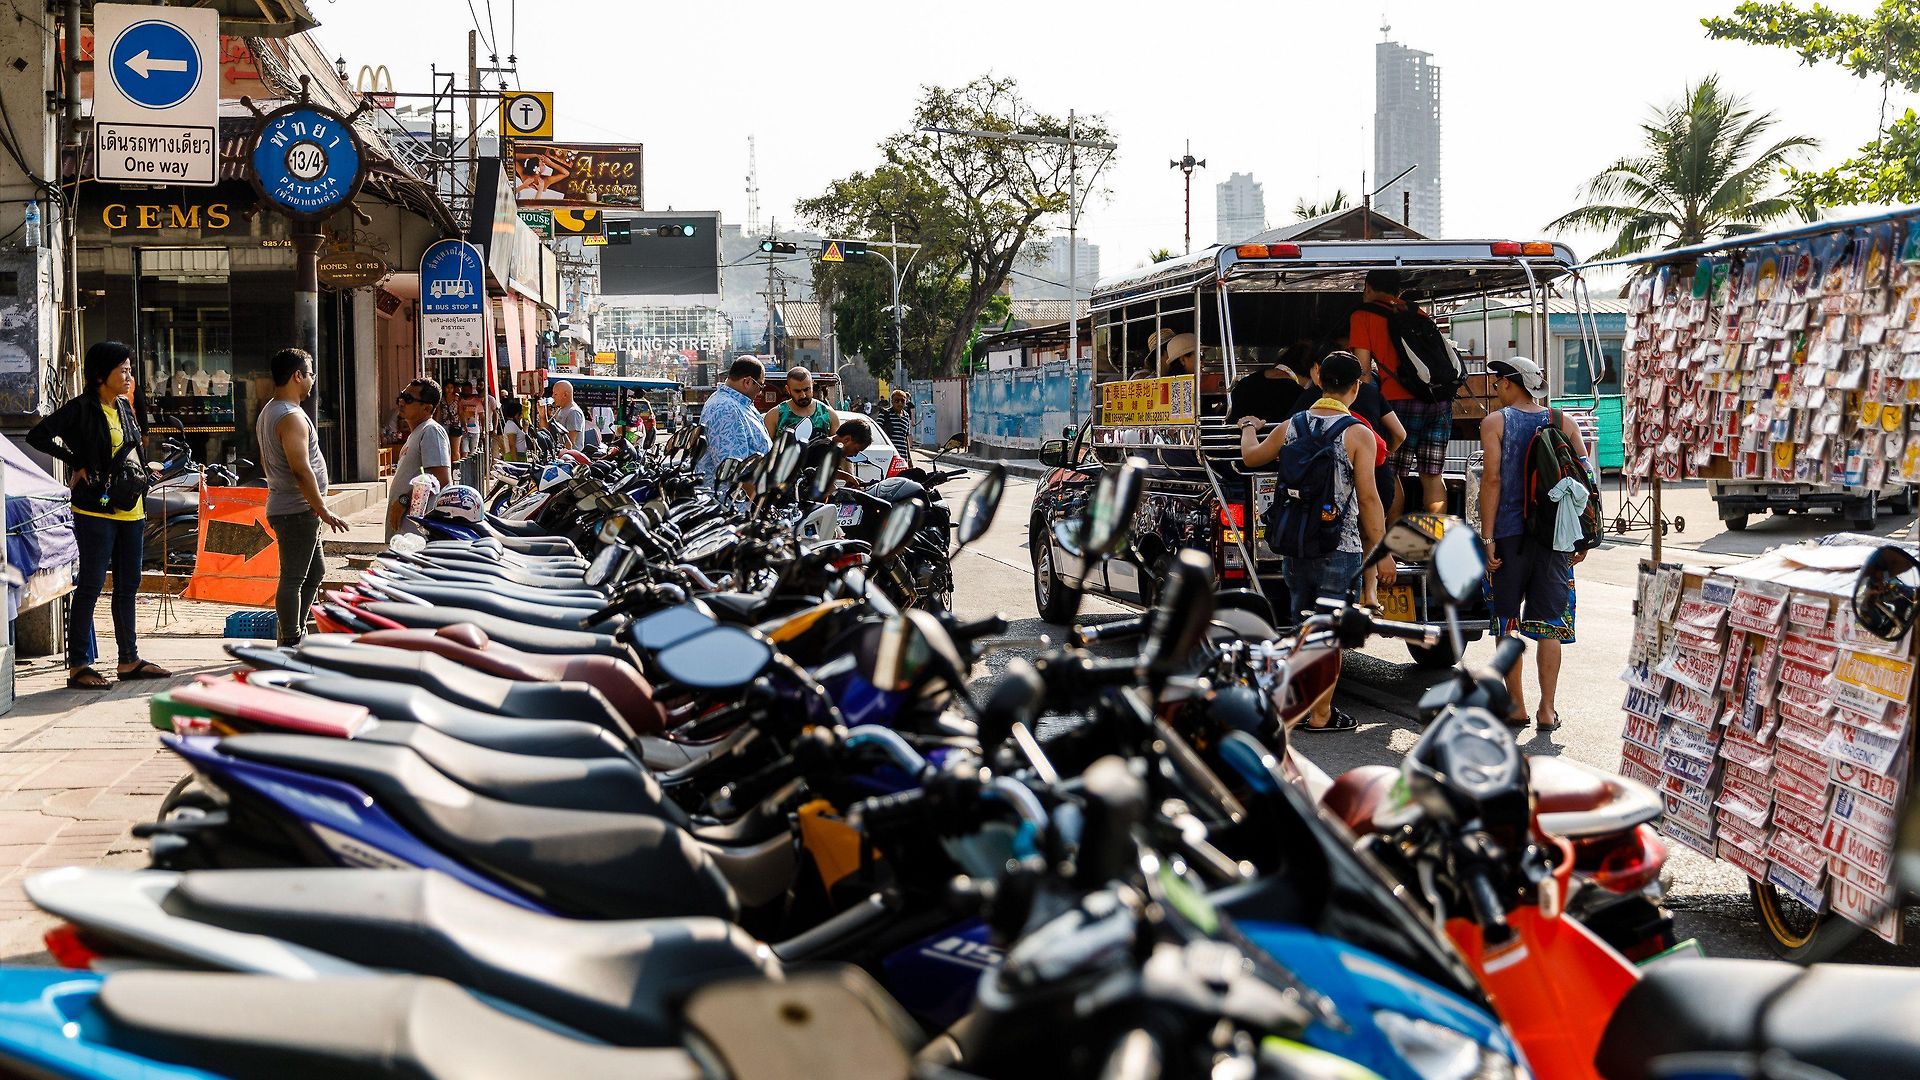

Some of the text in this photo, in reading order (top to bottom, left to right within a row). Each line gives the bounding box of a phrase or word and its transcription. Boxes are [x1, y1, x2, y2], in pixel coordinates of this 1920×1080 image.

[100, 130, 210, 154] เดินรถทางเดียว
[269, 119, 340, 149] พัทยา
[124, 156, 189, 177] One way
[292, 151, 321, 171] 13/4
[576, 155, 635, 178] Aree
[279, 176, 337, 195] PATTAYA
[568, 179, 637, 198] Massage
[102, 203, 231, 229] GEMS
[519, 213, 550, 226] HOUSE
[262, 239, 292, 247] 325/11
[451, 303, 470, 311] STOP
[596, 337, 726, 351] WALKING STREET
[1667, 755, 1708, 780] SLIDE
[1848, 836, 1888, 871] WOMEN
[1857, 870, 1887, 896] MEN
